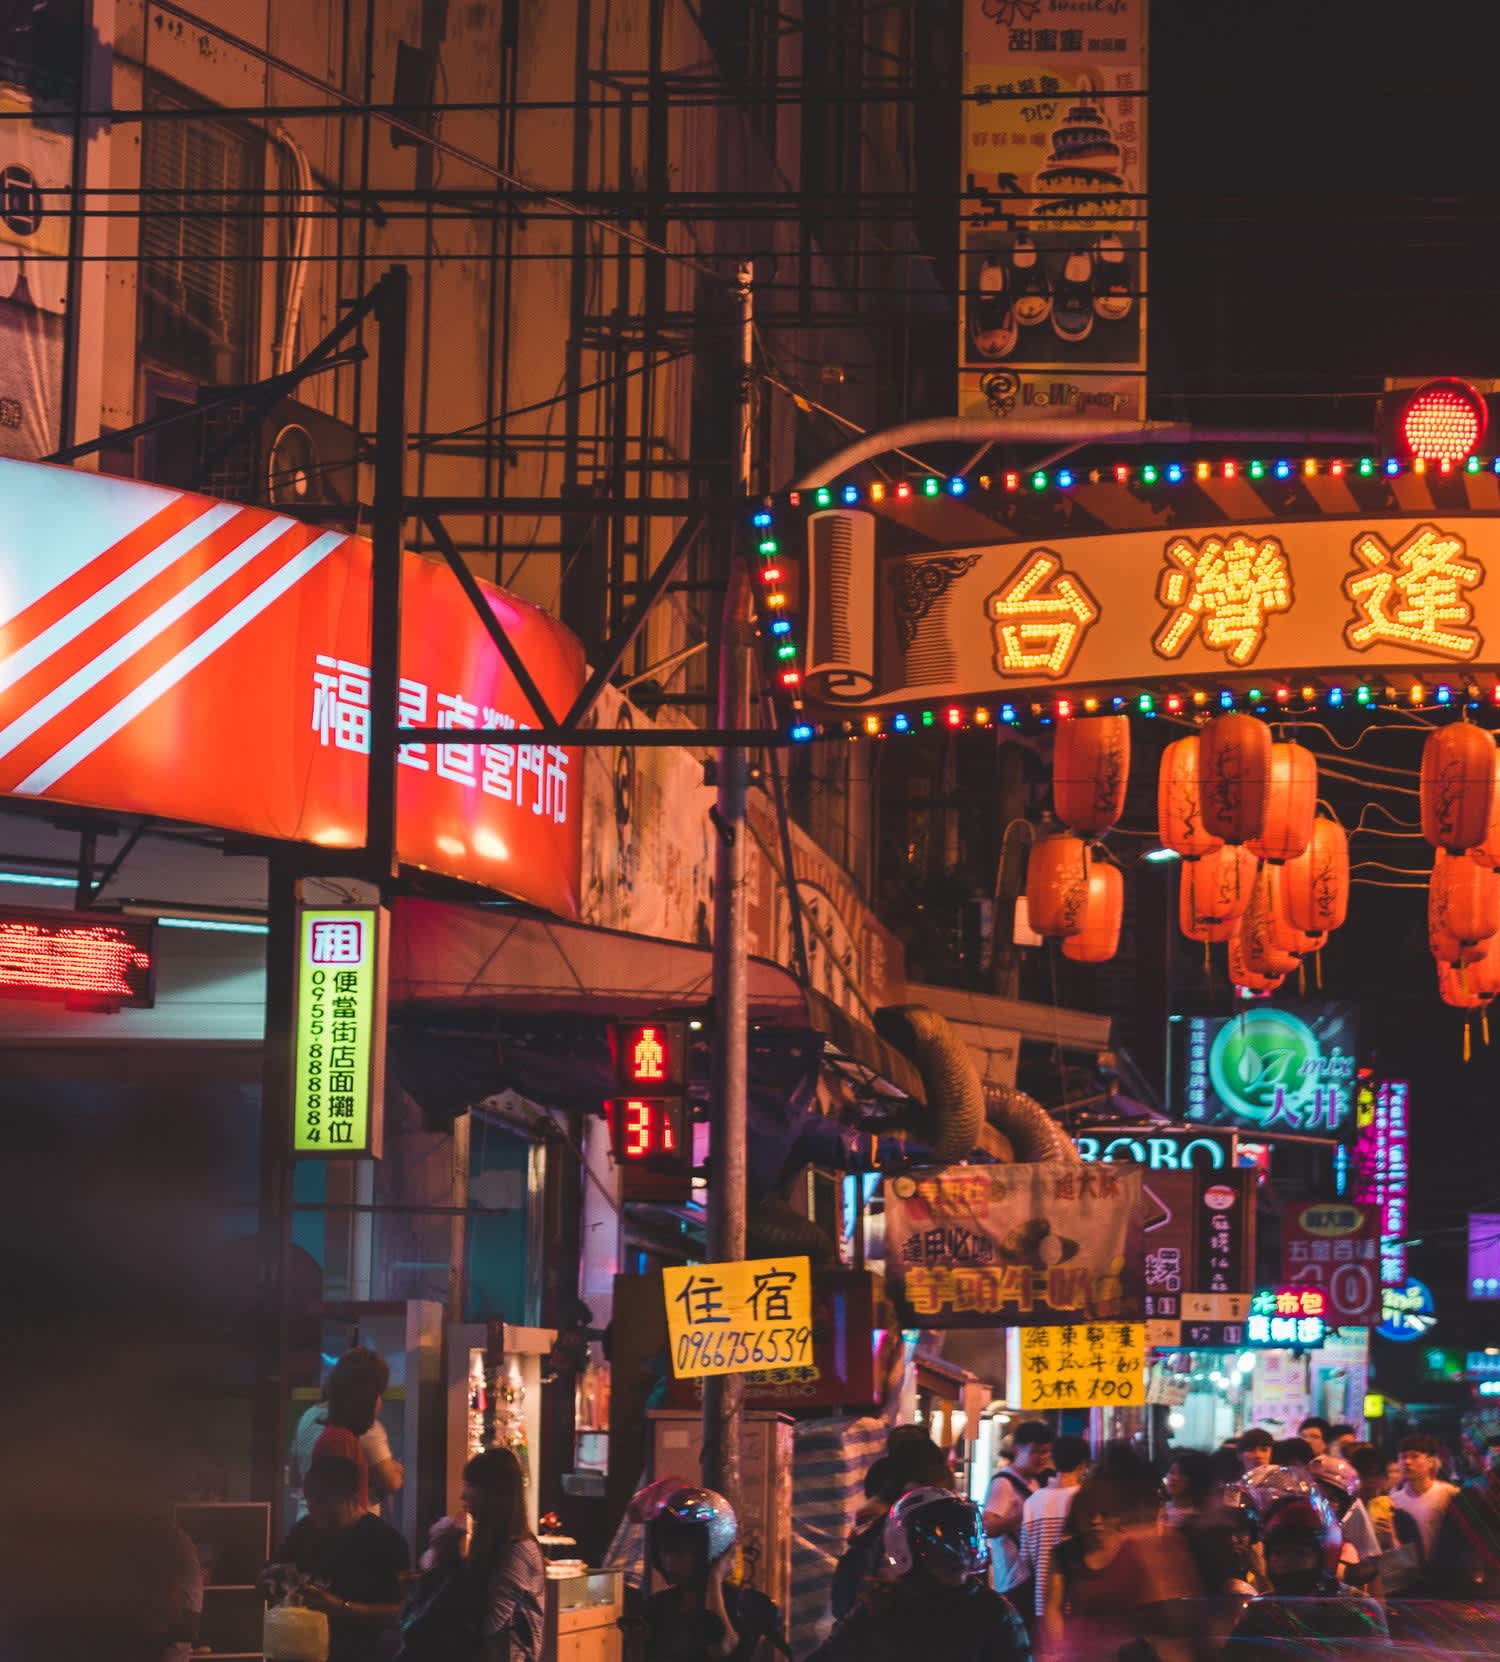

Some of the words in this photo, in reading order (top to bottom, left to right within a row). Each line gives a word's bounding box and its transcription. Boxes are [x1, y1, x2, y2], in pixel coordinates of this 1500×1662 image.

[315, 924, 361, 961] 租
[328, 970, 358, 1144] 便當街店面攤位
[676, 1268, 796, 1324] 住宿
[1088, 1378, 1133, 1400] 100
